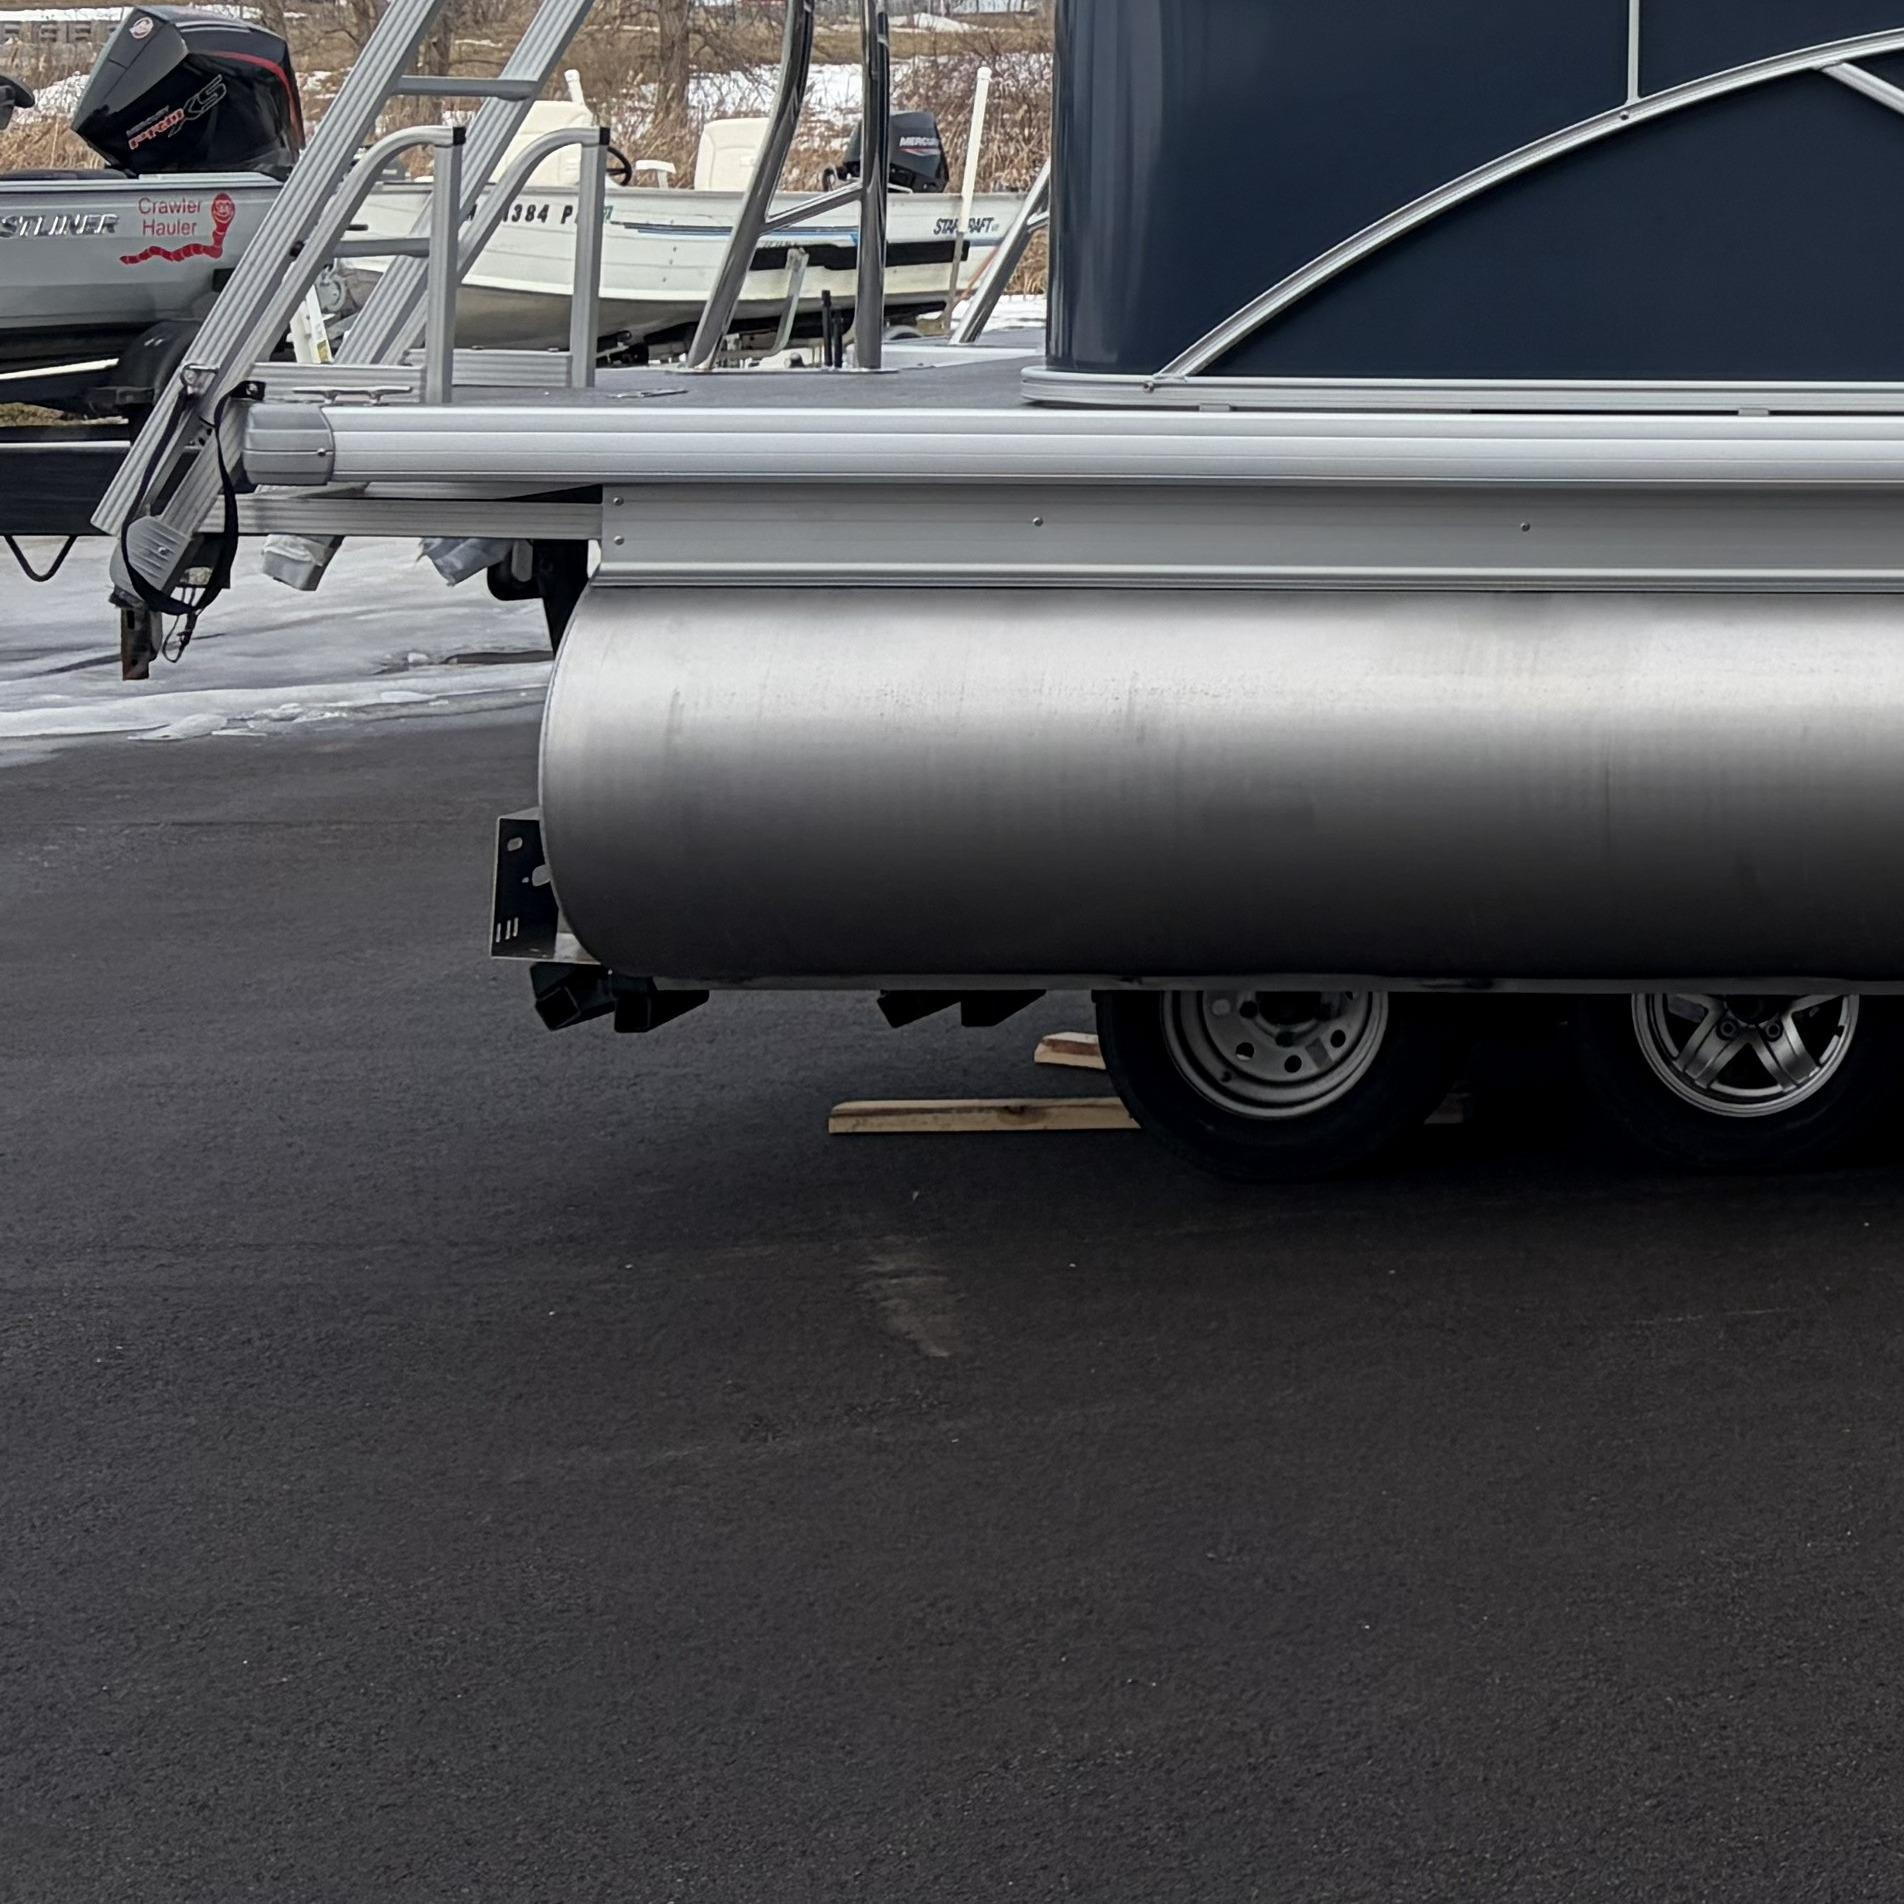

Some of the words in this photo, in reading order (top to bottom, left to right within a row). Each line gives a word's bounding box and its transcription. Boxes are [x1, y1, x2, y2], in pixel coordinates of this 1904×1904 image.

[138, 197, 202, 214] Crawler
[142, 219, 197, 237] Hauler
[933, 217, 995, 235] STARAFT
